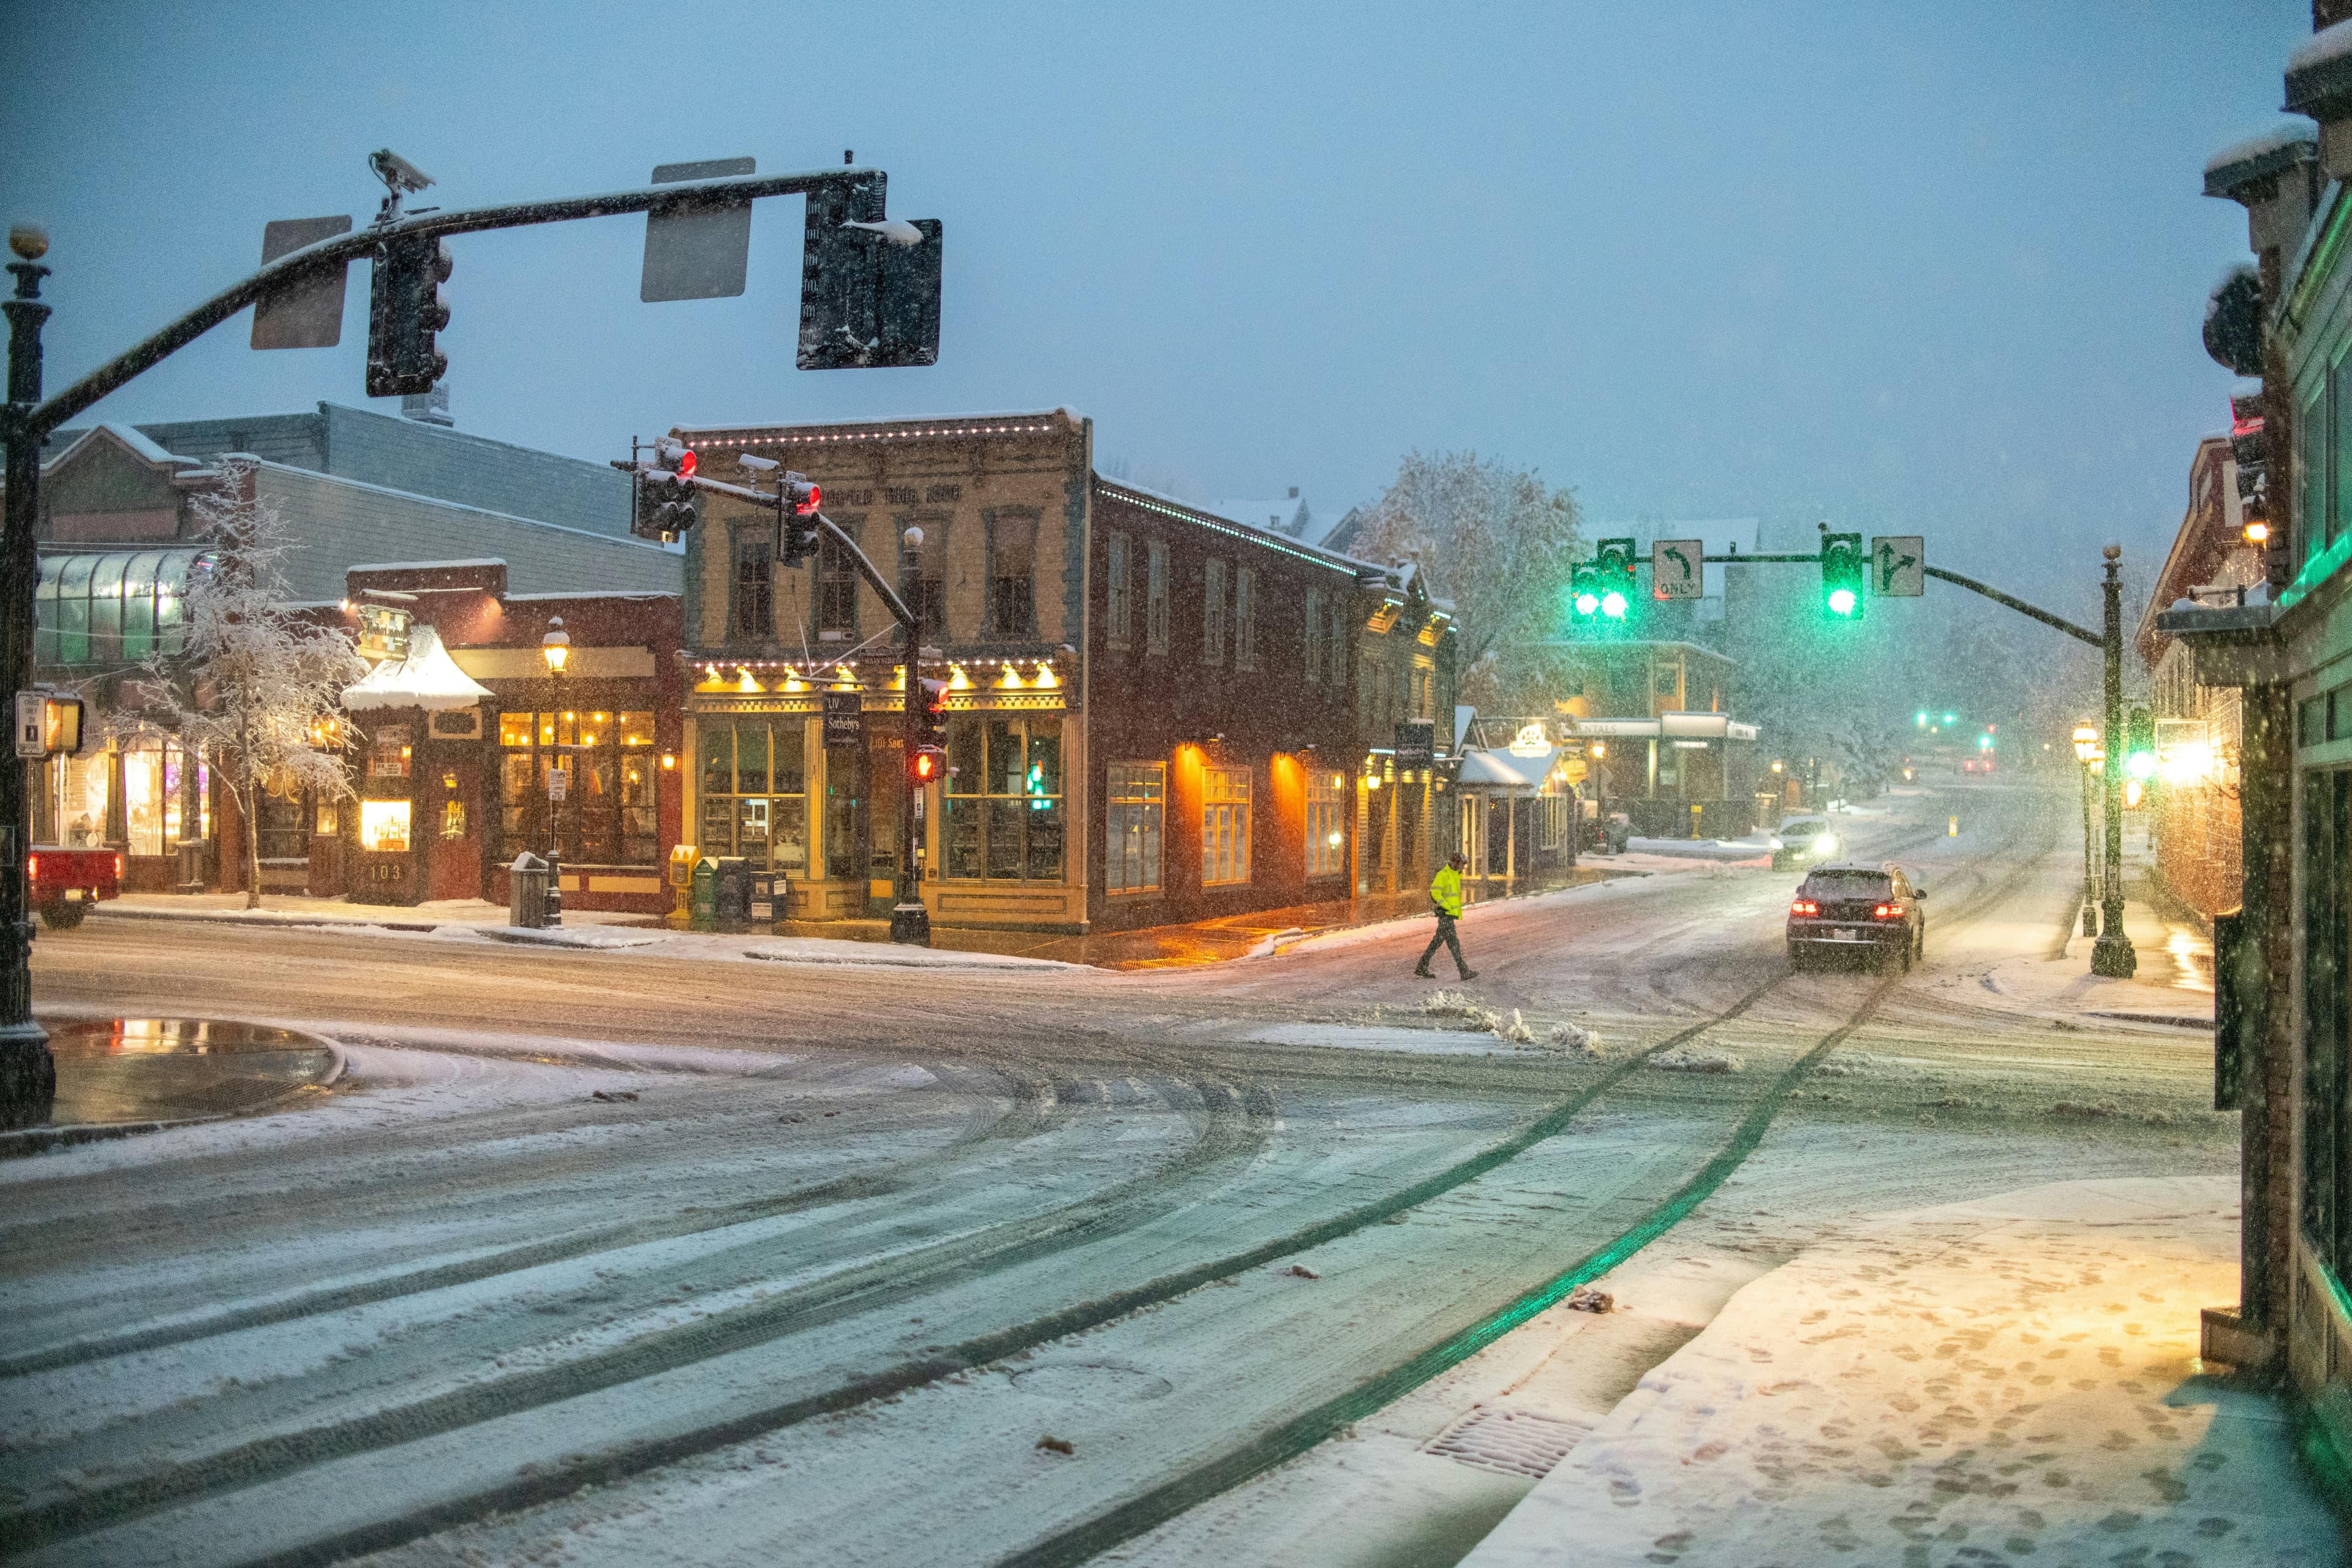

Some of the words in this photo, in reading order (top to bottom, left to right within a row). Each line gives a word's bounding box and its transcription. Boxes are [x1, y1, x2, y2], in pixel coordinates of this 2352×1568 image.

[1660, 582, 1695, 594] ONLY
[828, 696, 839, 709] LIV
[829, 716, 859, 733] Sotheby's
[1572, 725, 1617, 734] ENTALS
[372, 865, 400, 880] 103
